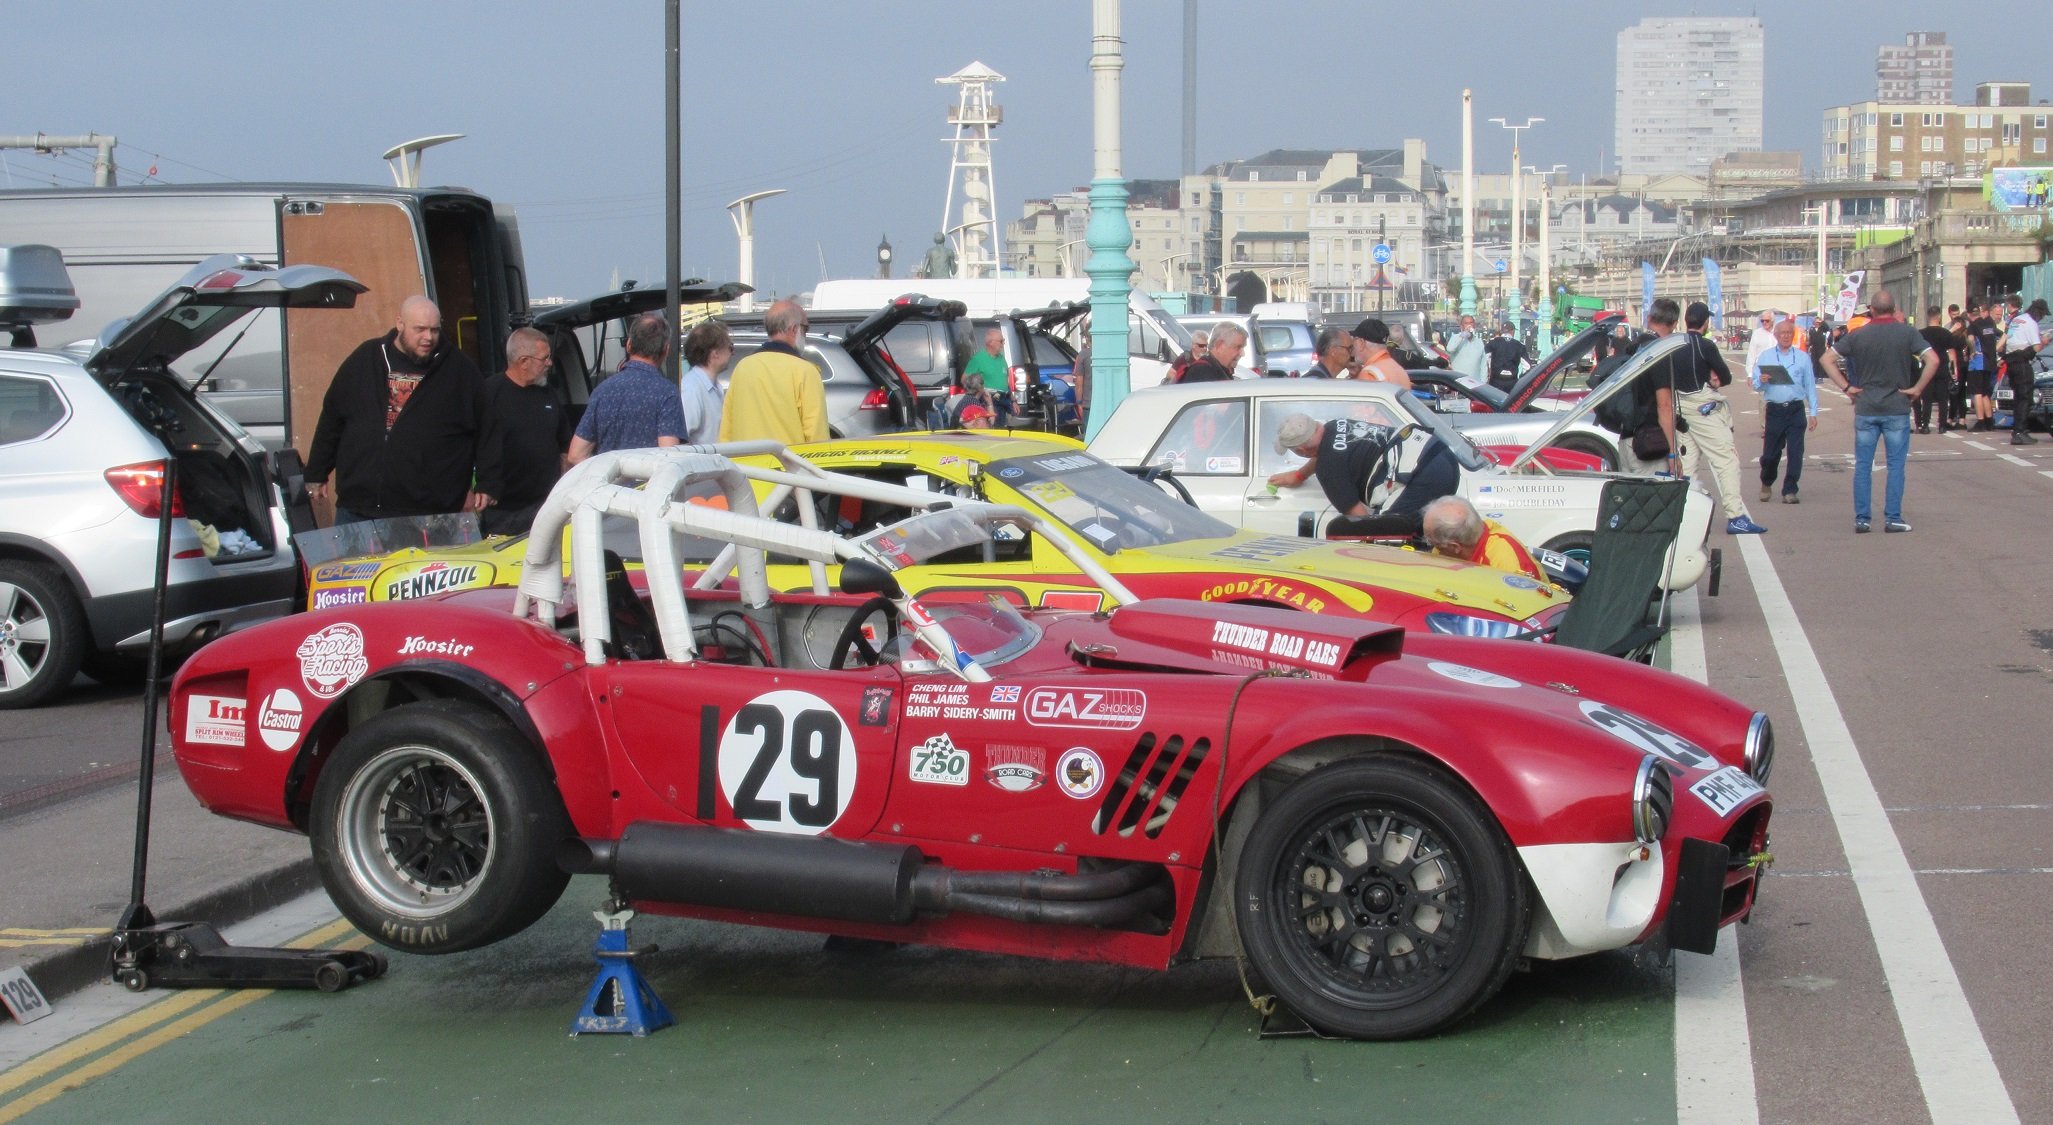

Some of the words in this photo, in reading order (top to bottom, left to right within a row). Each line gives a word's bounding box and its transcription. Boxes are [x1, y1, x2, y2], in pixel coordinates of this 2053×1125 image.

[1517, 485, 1565, 493] MERFIELD
[388, 566, 478, 602] PENNZOIL
[314, 588, 366, 609] Hoosier
[1201, 580, 1326, 614] GOODYEAR
[299, 633, 361, 657] Sports
[397, 635, 475, 657] Hoosier
[1212, 620, 1269, 652] THUNDER
[1269, 632, 1305, 659] ROAD
[1305, 640, 1340, 666] CARS
[304, 656, 368, 683] Racing
[908, 693, 932, 704] PHIL
[933, 694, 969, 705] JAMES
[912, 684, 946, 693] CHENG
[948, 684, 968, 693] LIM
[906, 706, 940, 718] BARRY
[943, 707, 1017, 721] SIDERY-SMITH
[1031, 691, 1105, 720] GAZ
[1098, 703, 1142, 714] SHOCKS
[263, 710, 302, 730] Castrol
[914, 752, 966, 776] 750
[986, 743, 1047, 776] THUNDER
[998, 768, 1016, 777] ROAD
[1017, 769, 1033, 778] CARS
[1696, 775, 1743, 811] PMF
[2, 978, 43, 1014] 129
